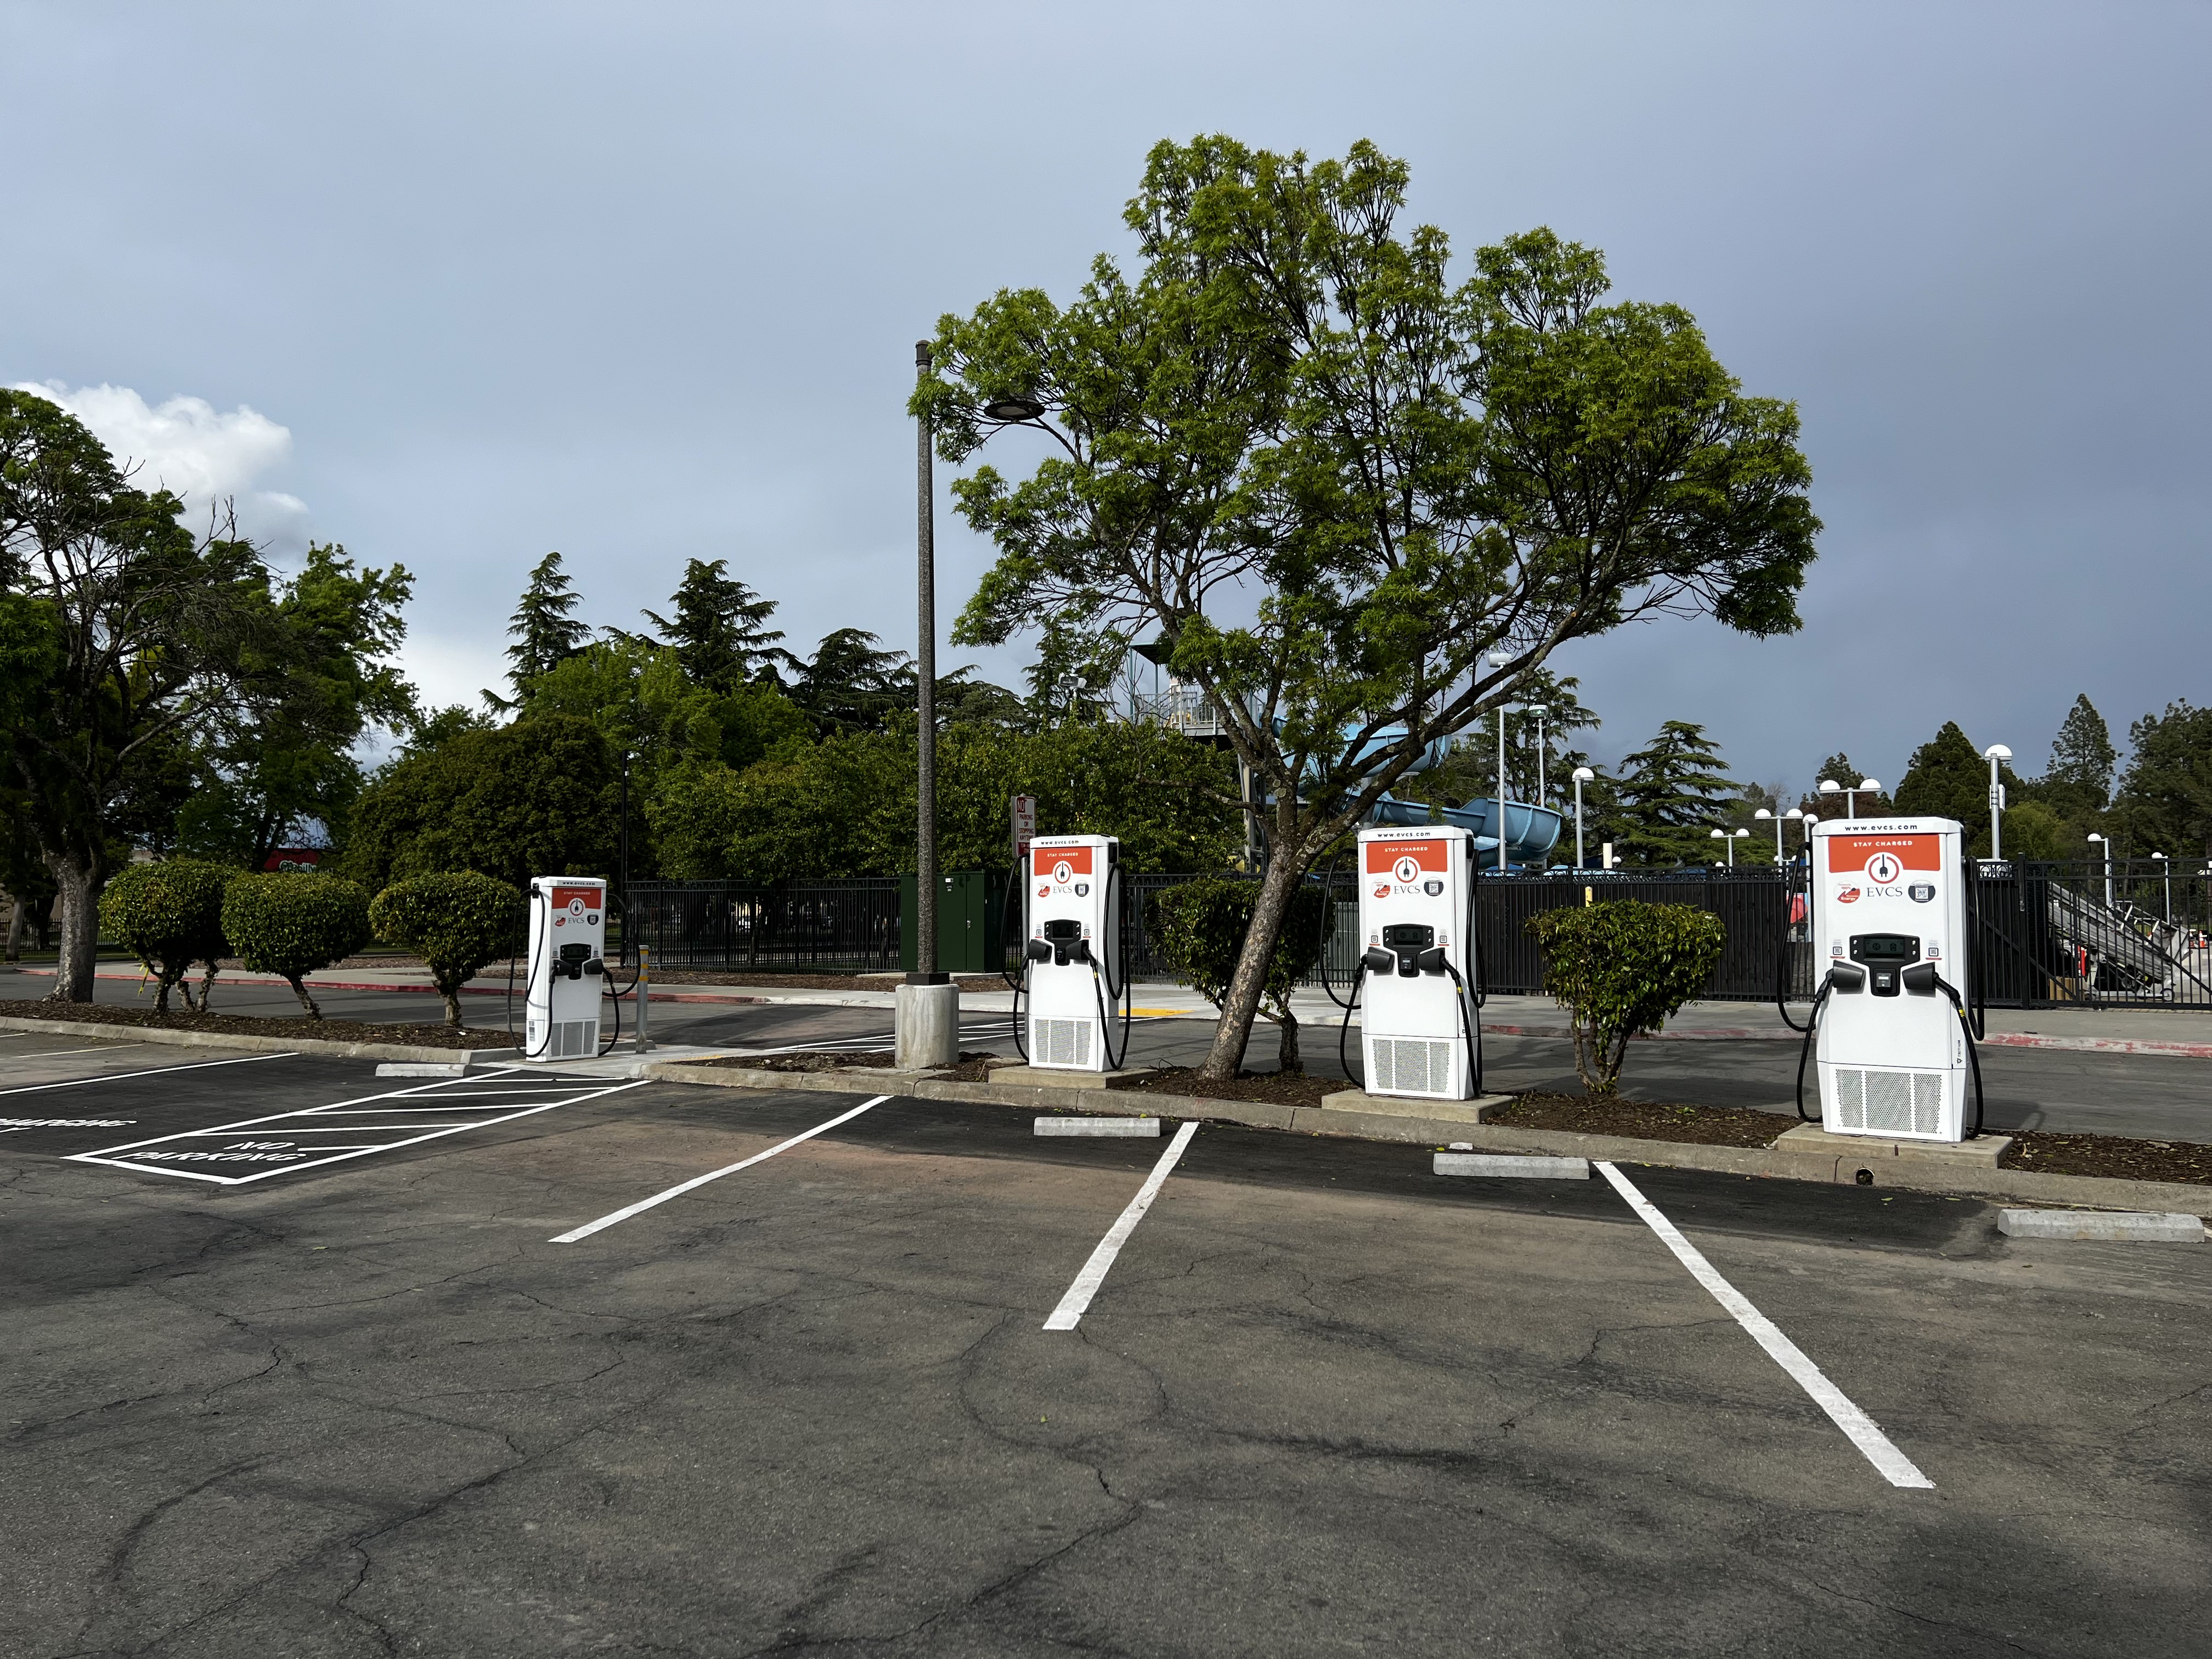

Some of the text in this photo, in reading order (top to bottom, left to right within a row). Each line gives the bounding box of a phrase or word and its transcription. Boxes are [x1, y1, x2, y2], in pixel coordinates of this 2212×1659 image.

[1017, 799, 1025, 811] NO
[1053, 885, 1072, 894] EVCS
[1393, 885, 1420, 894] EVCS
[1867, 887, 1903, 897] EVCS
[224, 1141, 295, 1150] NO
[111, 1152, 307, 1161] PARKING
